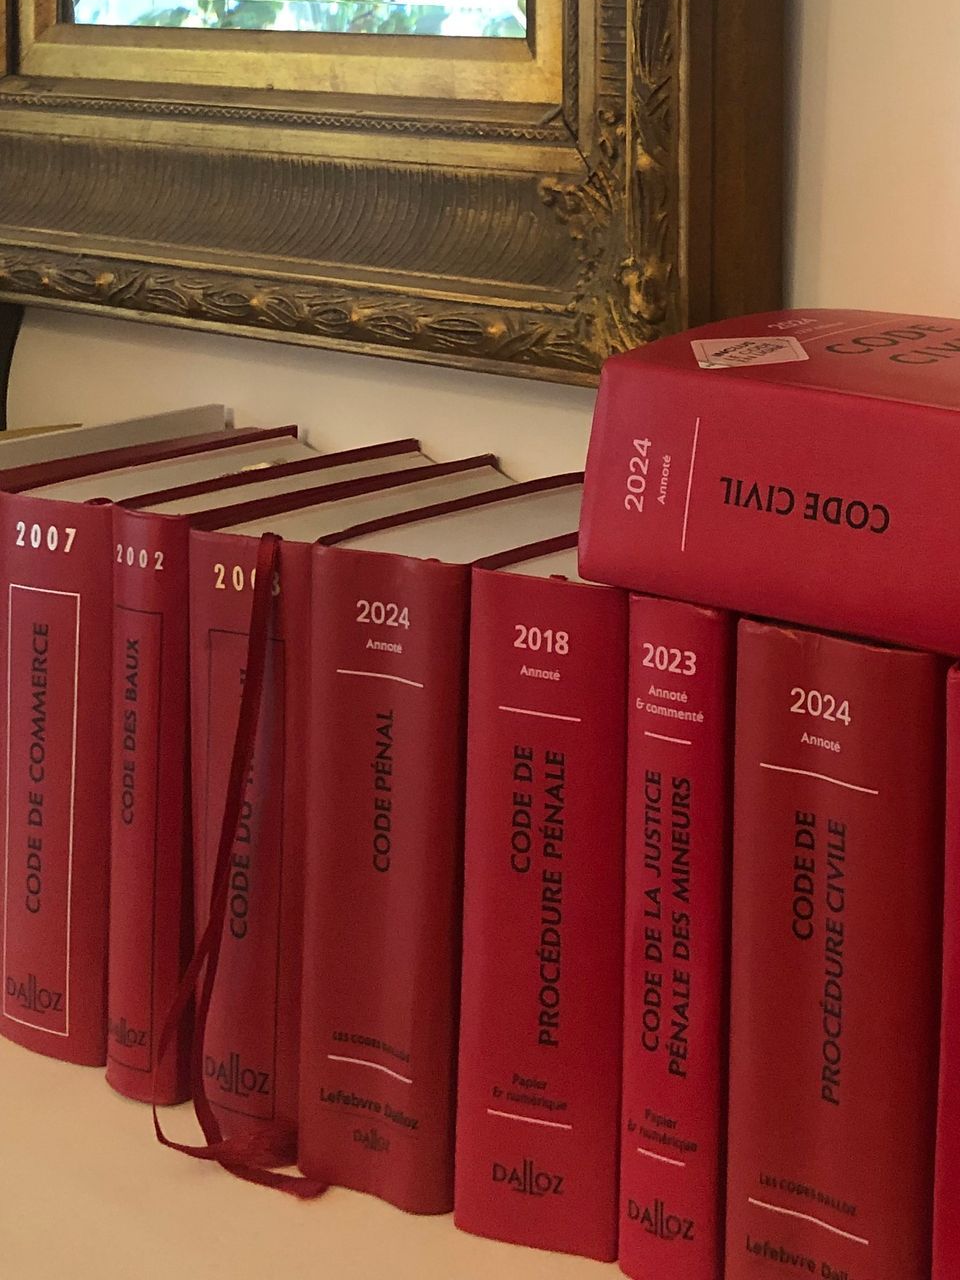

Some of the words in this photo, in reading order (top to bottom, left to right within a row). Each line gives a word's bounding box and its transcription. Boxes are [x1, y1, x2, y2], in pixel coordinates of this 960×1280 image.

[825, 324, 952, 355] CODE
[624, 437, 652, 513] 2024
[656, 454, 672, 505] Annoté
[719, 476, 796, 516] CIVIL
[803, 492, 890, 534] CODE
[15, 521, 77, 552] 2007
[116, 543, 164, 570] 2002
[356, 600, 411, 629] 2024
[366, 638, 403, 654] Annoté
[513, 624, 569, 655] 2018
[641, 642, 697, 676] 2023
[125, 638, 140, 703] BAUX
[520, 665, 561, 681] Annoté
[28, 622, 49, 785] COMMERCE
[635, 697, 645, 709] &
[645, 702, 705, 723] commenté
[648, 685, 688, 703] Annoté
[789, 687, 852, 727] 2024
[123, 710, 137, 752] DES
[371, 709, 395, 793] PÉNAL
[800, 731, 841, 754] Annoté
[513, 744, 534, 784] DE
[27, 791, 44, 827] DE
[121, 760, 135, 826] CODE
[538, 750, 566, 861] PÉNALE
[372, 797, 393, 873] CODE
[511, 791, 533, 874] CODE
[644, 769, 662, 879] JUSTICE
[671, 775, 692, 904] MINEURS
[795, 810, 817, 851] DE
[25, 834, 43, 914] CODE
[826, 819, 848, 914] CIVILE
[229, 850, 250, 940] CODE
[644, 886, 662, 921] LA
[792, 855, 816, 942] CODE
[644, 926, 663, 964] DE
[672, 908, 691, 963] DES
[536, 869, 563, 1049] PROCÉDURE
[6, 973, 64, 1014] DALLOZ
[641, 973, 662, 1053] CODE
[820, 918, 846, 1108] PROCÉDURE
[665, 969, 691, 1080] PÉNALE
[492, 1159, 564, 1196] DALLOZ
[627, 1198, 695, 1241] DALLOZ
[746, 1234, 816, 1273] Lefebvre
